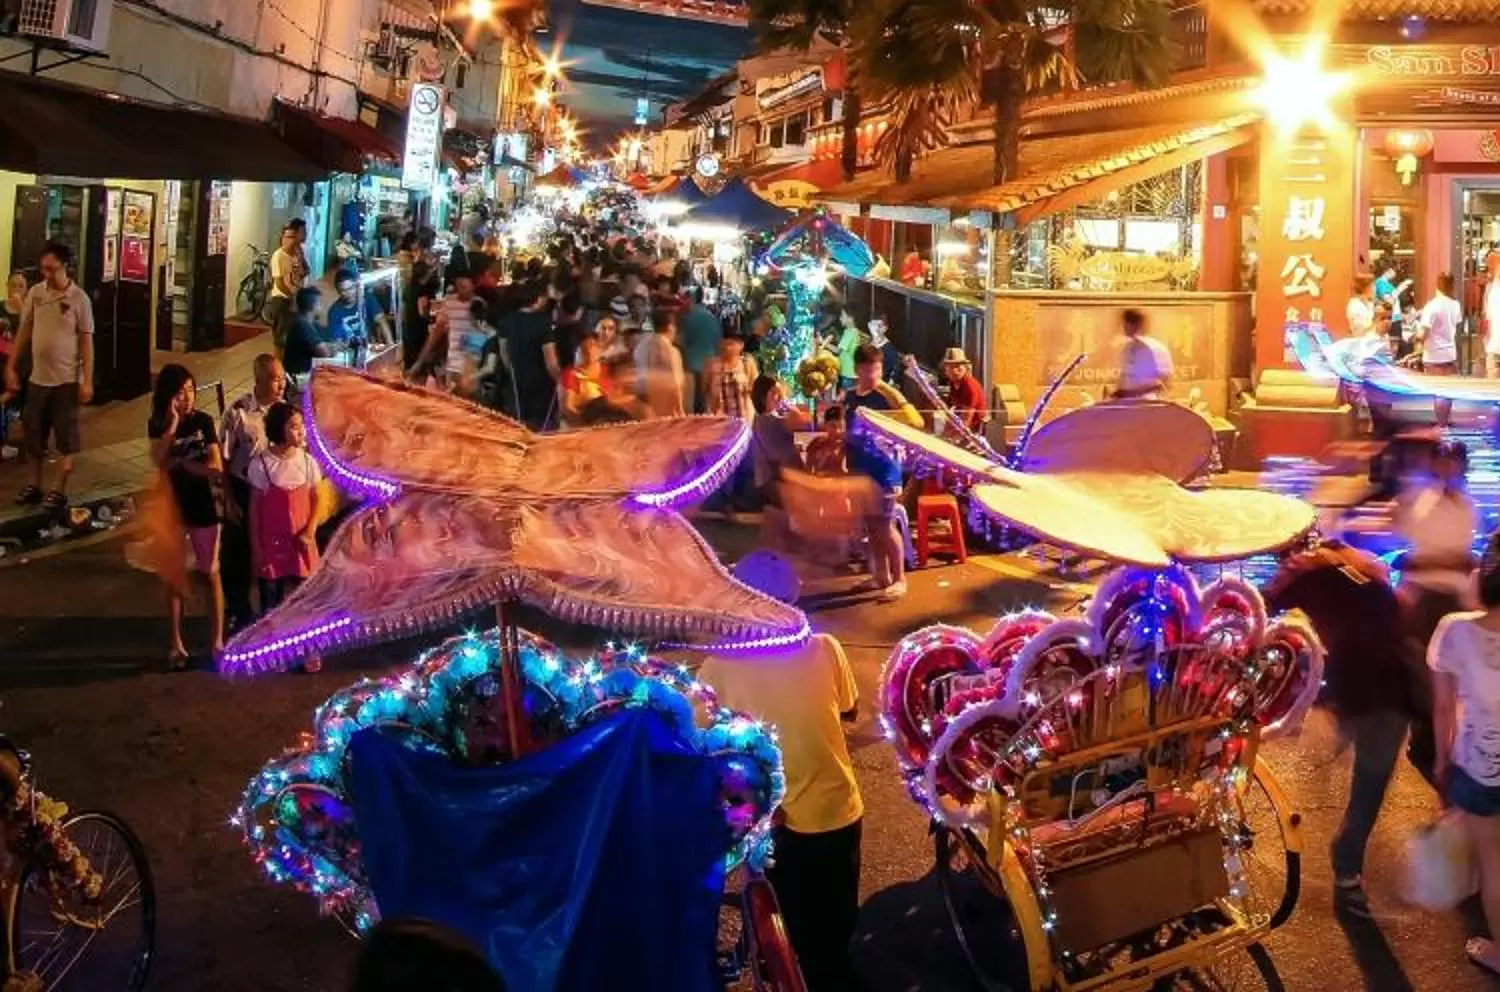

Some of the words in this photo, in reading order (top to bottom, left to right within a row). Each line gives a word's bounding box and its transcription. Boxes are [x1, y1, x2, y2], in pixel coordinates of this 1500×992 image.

[1366, 45, 1455, 75] San
[1280, 140, 1326, 297] 三叔公
